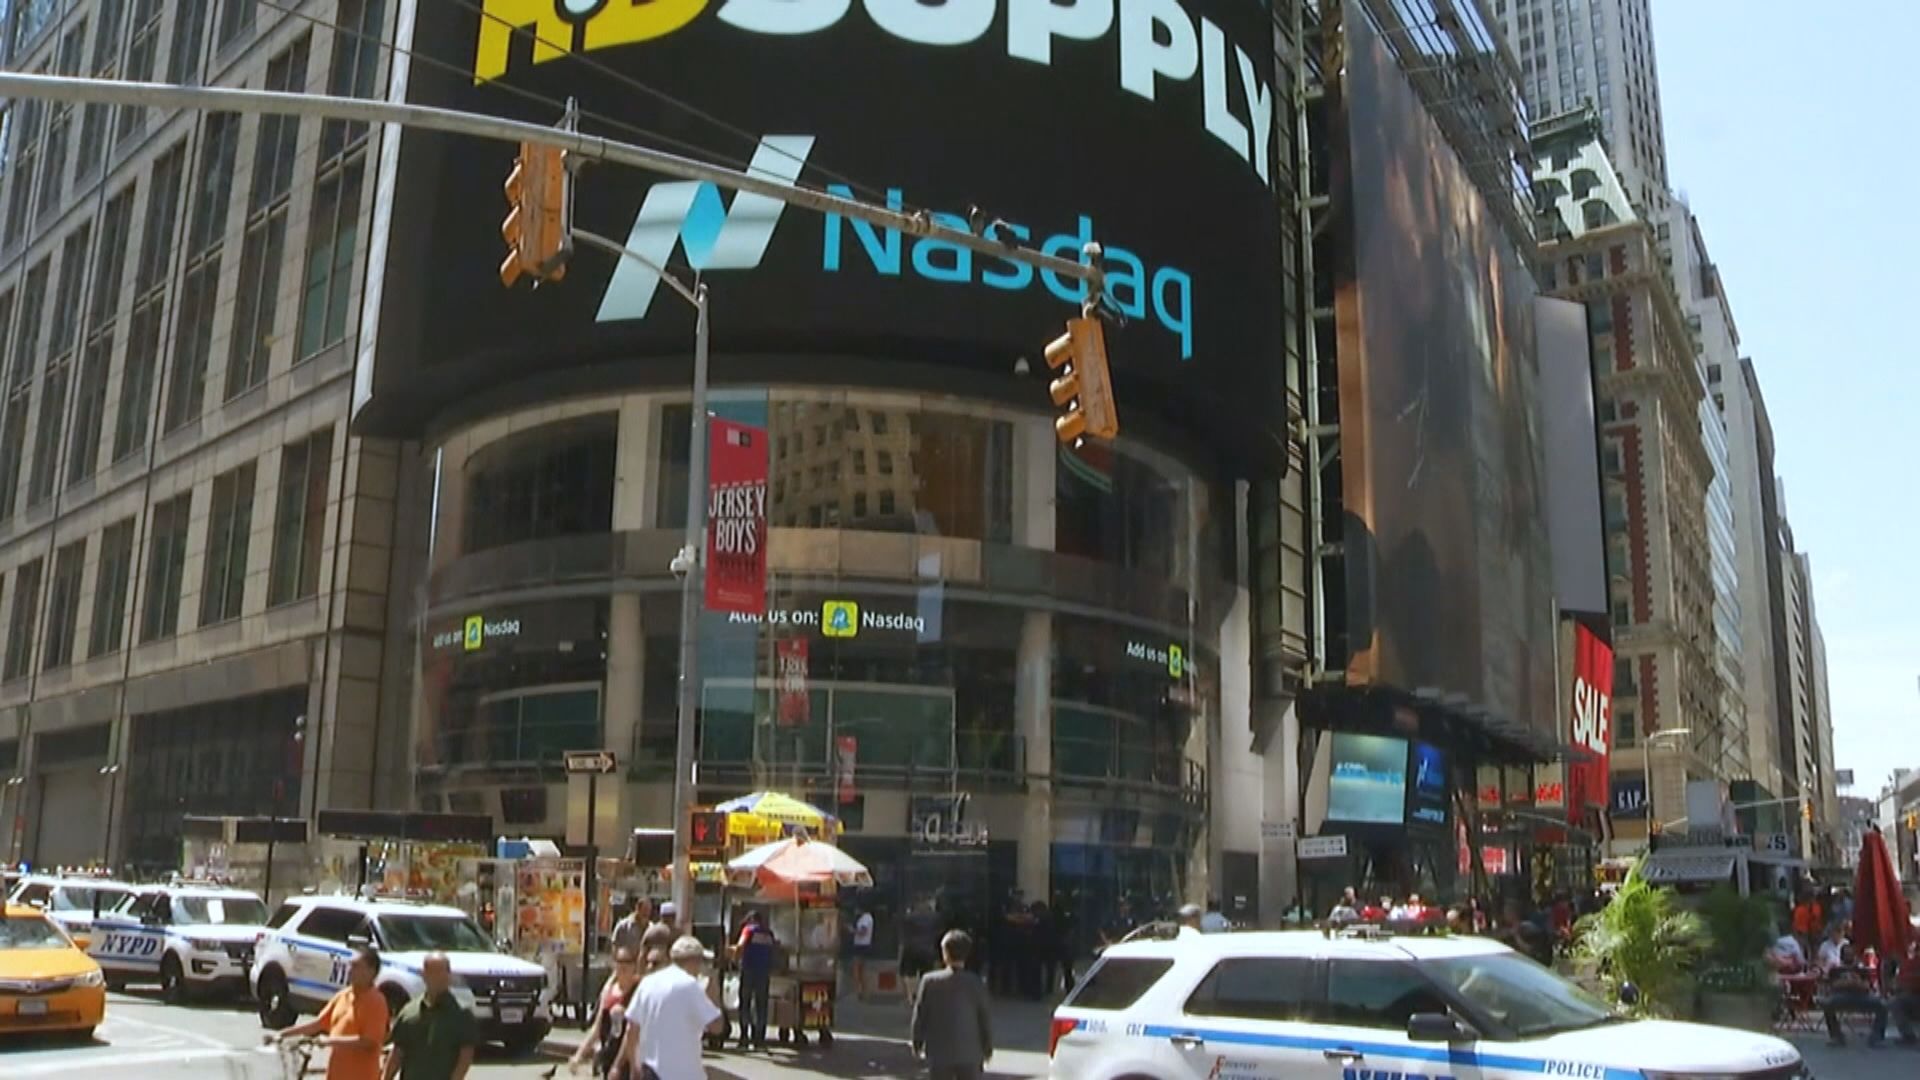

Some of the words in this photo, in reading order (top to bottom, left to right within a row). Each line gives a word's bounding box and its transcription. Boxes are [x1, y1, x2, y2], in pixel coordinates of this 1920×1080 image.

[716, 0, 1272, 185] PPLY
[823, 184, 1192, 360] Nasdaq
[709, 483, 766, 520] JERSEY
[716, 517, 757, 554] BOYS
[767, 609, 788, 624] us
[792, 610, 818, 625] on:
[862, 611, 924, 633] Nasdaq
[1574, 677, 1608, 755] SALE
[1618, 790, 1641, 809] GAP
[101, 934, 157, 956] NYPD
[1547, 1060, 1602, 1080] POLICE
